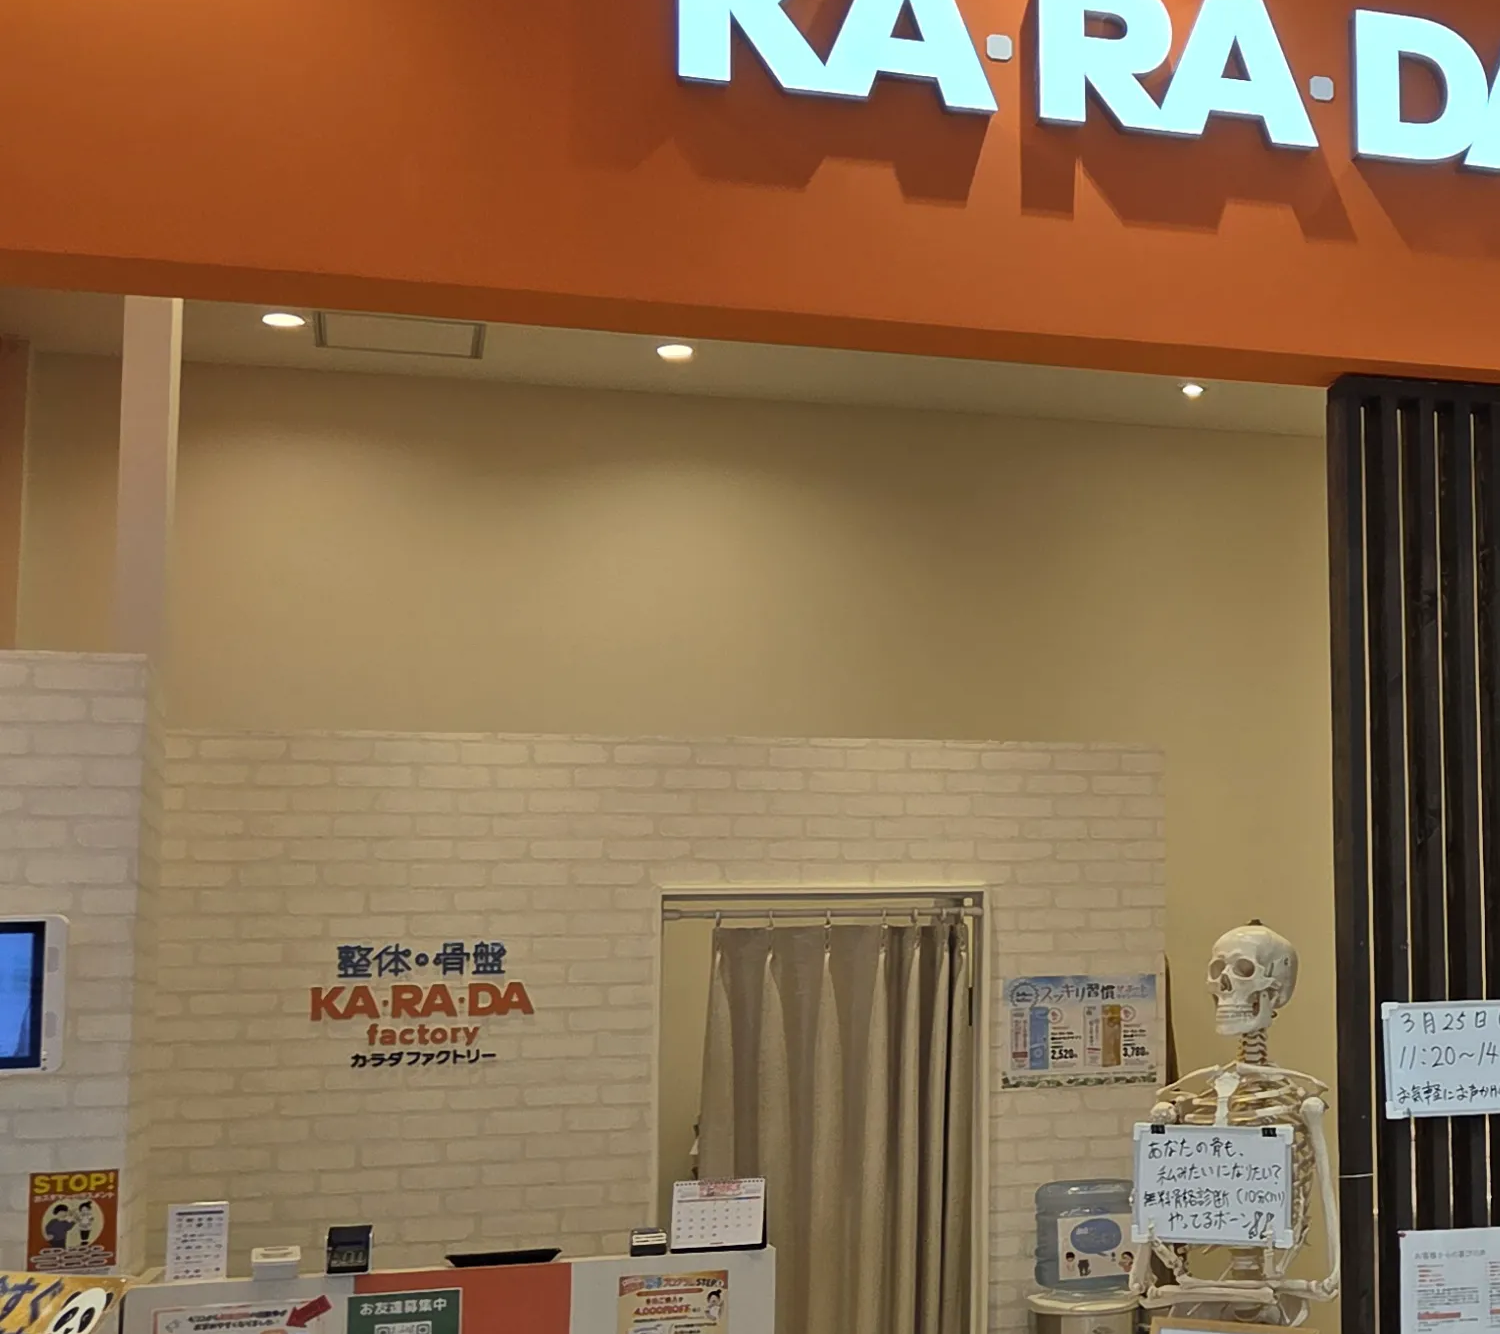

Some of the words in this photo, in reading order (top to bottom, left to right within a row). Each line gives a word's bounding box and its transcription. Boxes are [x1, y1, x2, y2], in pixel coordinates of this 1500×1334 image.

[367, 1023, 482, 1047] factory
[34, 1172, 115, 1194] STOP!
[360, 1298, 447, 1316] お友達募集中
